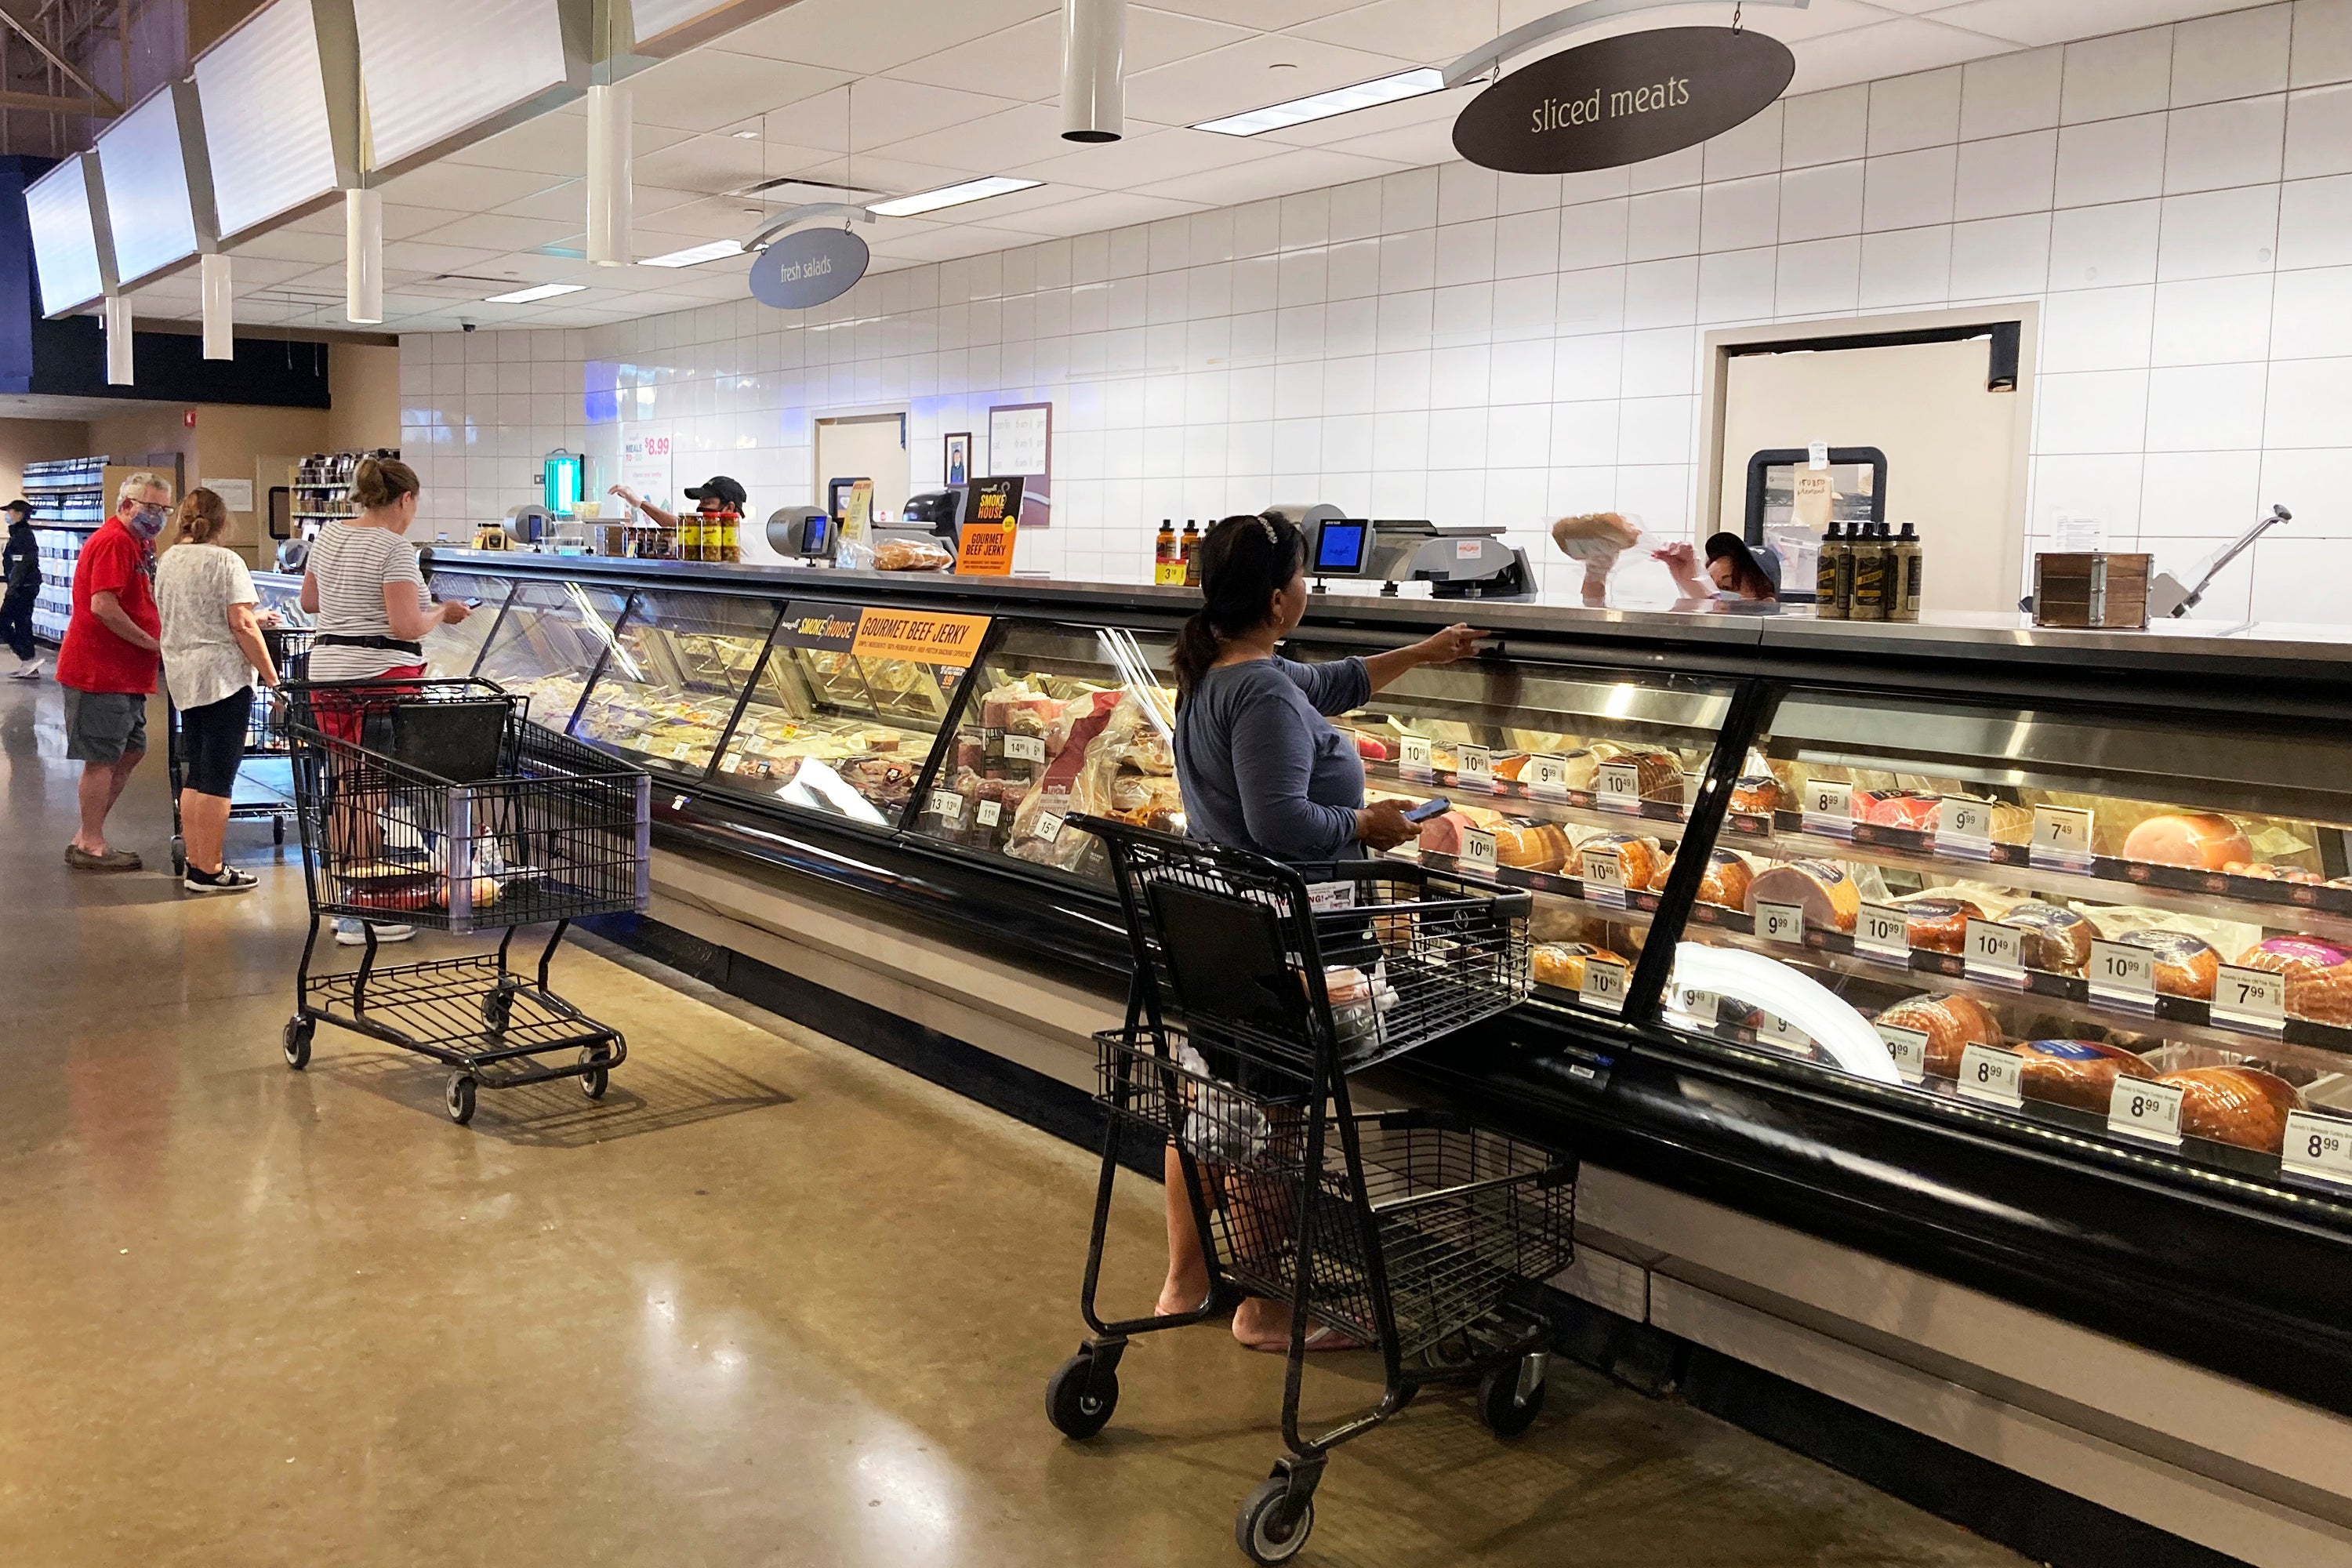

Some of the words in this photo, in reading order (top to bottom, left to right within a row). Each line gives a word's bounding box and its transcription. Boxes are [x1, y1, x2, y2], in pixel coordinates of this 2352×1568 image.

[1530, 88, 1600, 134] sliced
[1610, 76, 1690, 118] meats
[781, 261, 801, 282] fresh
[803, 256, 832, 278] salads
[644, 437, 669, 455] $8.99
[979, 494, 1006, 506] SMOKE
[978, 506, 1004, 518] HOUSE
[972, 533, 1004, 544] GOURMET
[966, 545, 983, 555] BEEF
[983, 545, 1006, 556] JERKY
[798, 618, 827, 636] SMOKE
[825, 621, 855, 639] HOUSE
[861, 617, 909, 640] GOURMET
[906, 622, 935, 641] BEEF
[932, 624, 970, 645] JERKY
